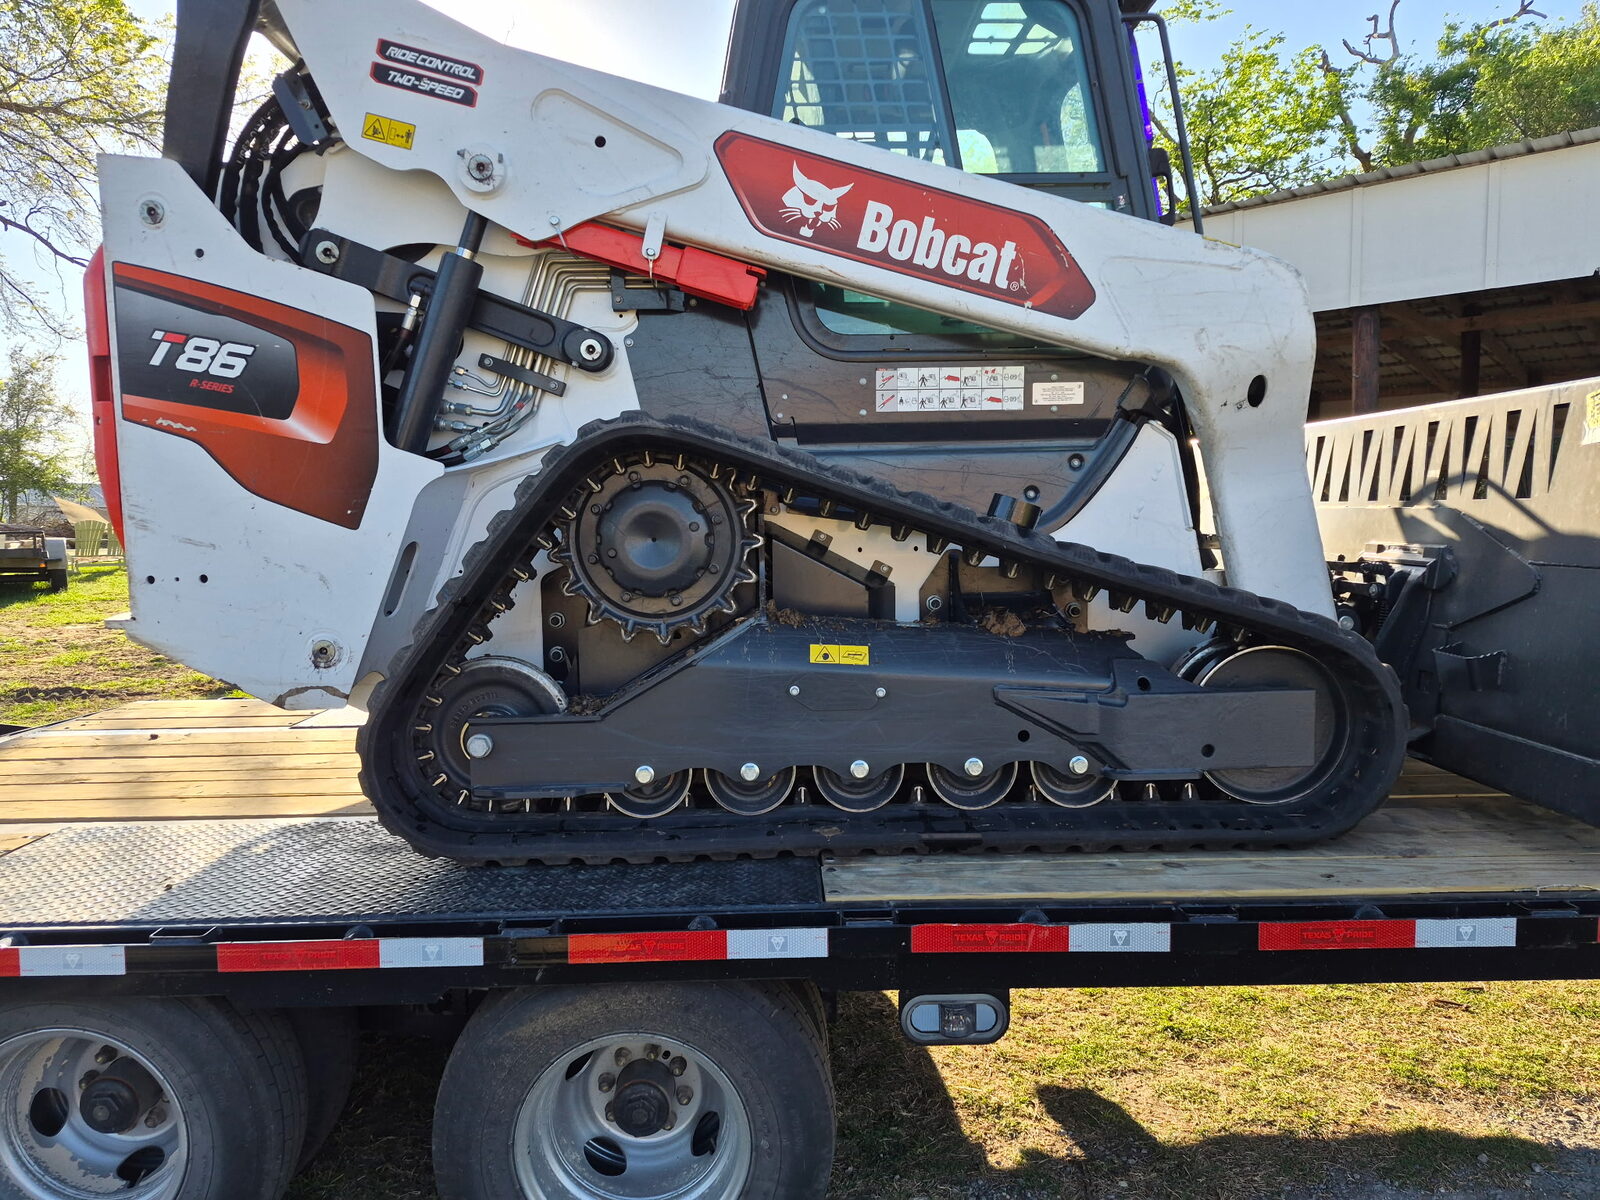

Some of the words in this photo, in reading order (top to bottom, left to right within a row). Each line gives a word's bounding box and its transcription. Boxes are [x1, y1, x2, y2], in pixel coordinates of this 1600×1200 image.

[386, 46, 418, 63] RIDE
[416, 54, 476, 80] CONTROL
[387, 70, 465, 99] TWO-SPEED
[857, 200, 1017, 290] Bobcat
[149, 330, 255, 378] T86
[189, 379, 234, 394] R-SERIES
[954, 933, 984, 941] TEXAS
[1000, 933, 1027, 941] PRIDE
[1303, 931, 1332, 939] TEXAS
[1345, 930, 1374, 938] PRIDE
[658, 942, 685, 950] PRIDE
